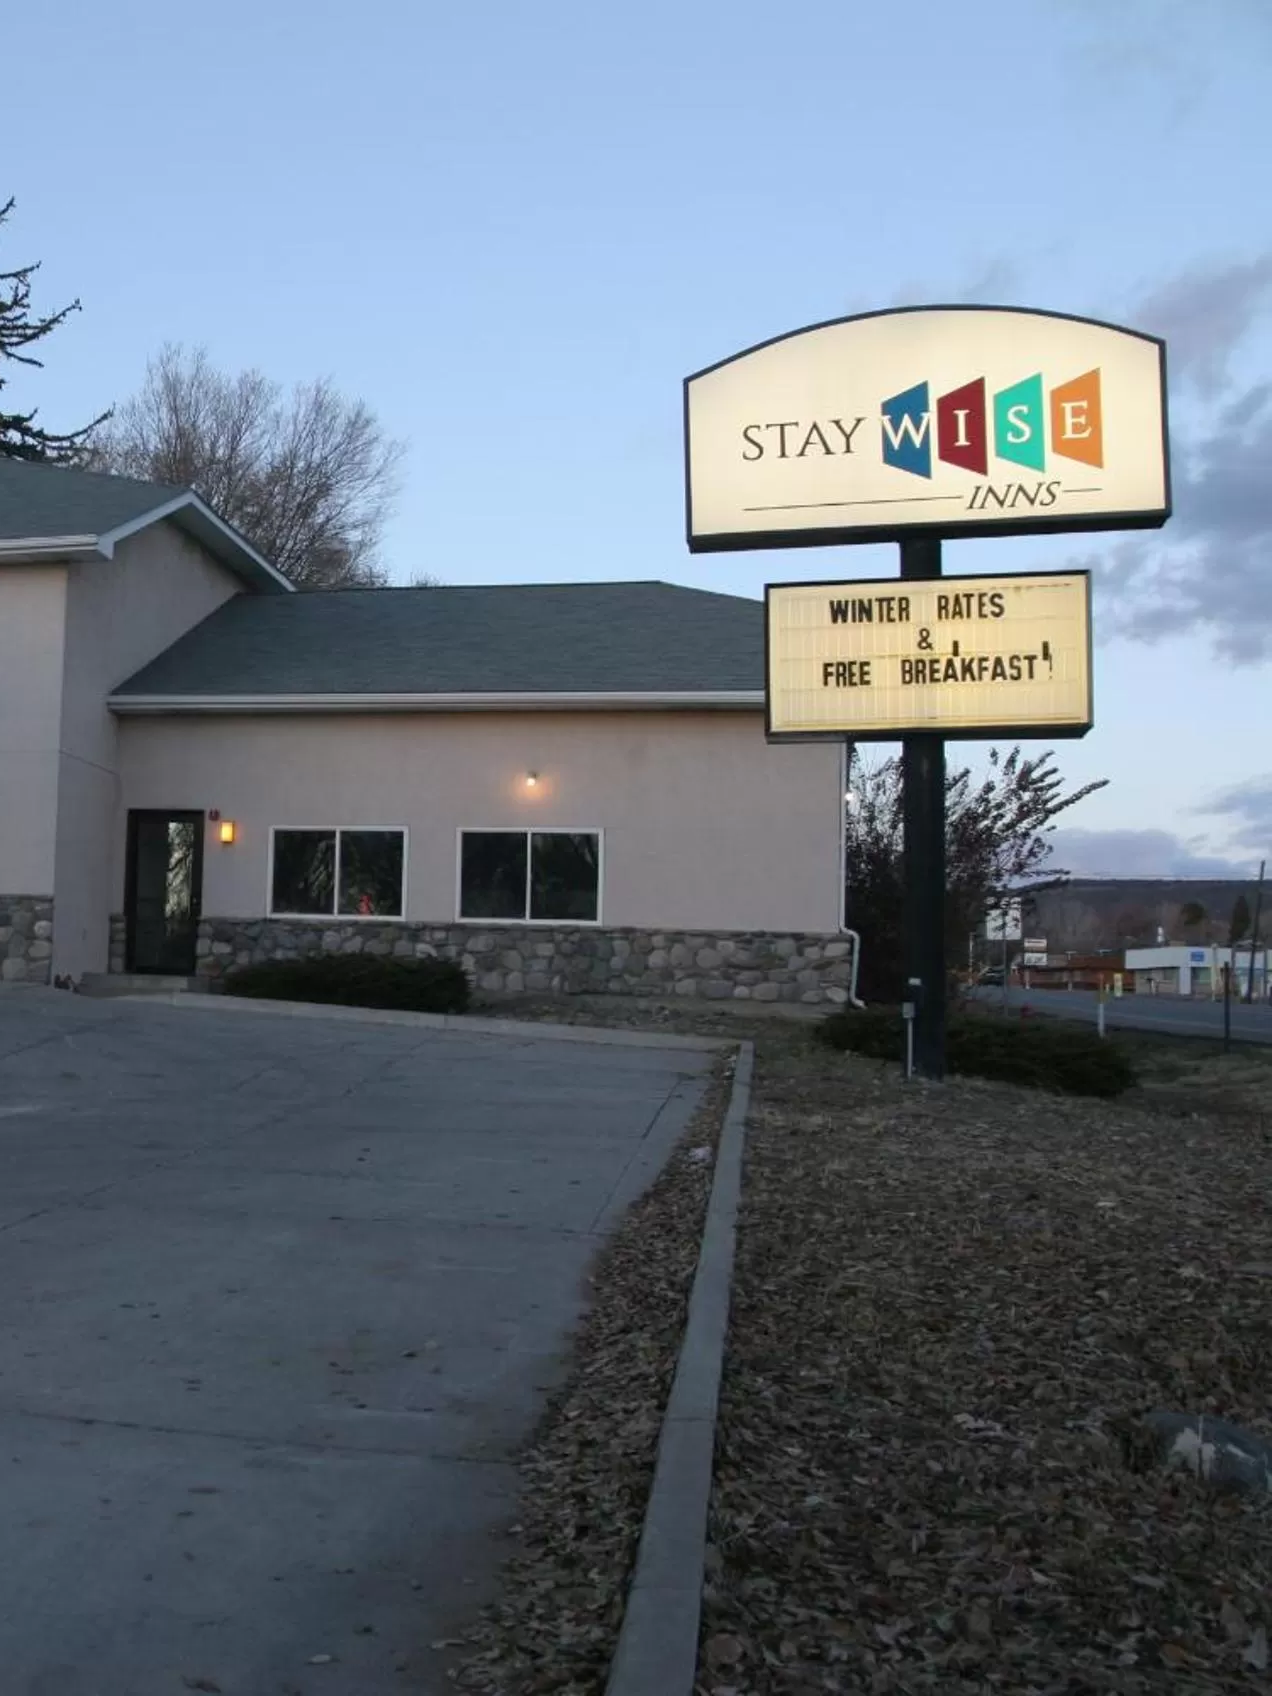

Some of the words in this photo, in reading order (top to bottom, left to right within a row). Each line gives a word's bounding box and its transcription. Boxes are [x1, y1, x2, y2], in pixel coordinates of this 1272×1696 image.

[742, 417, 867, 461] STAY
[882, 400, 1093, 450] WISE
[966, 481, 1061, 510] INNS
[829, 597, 910, 624] WINTER
[937, 592, 1005, 620] RATES
[917, 628, 933, 650] &
[823, 661, 871, 687] FREE
